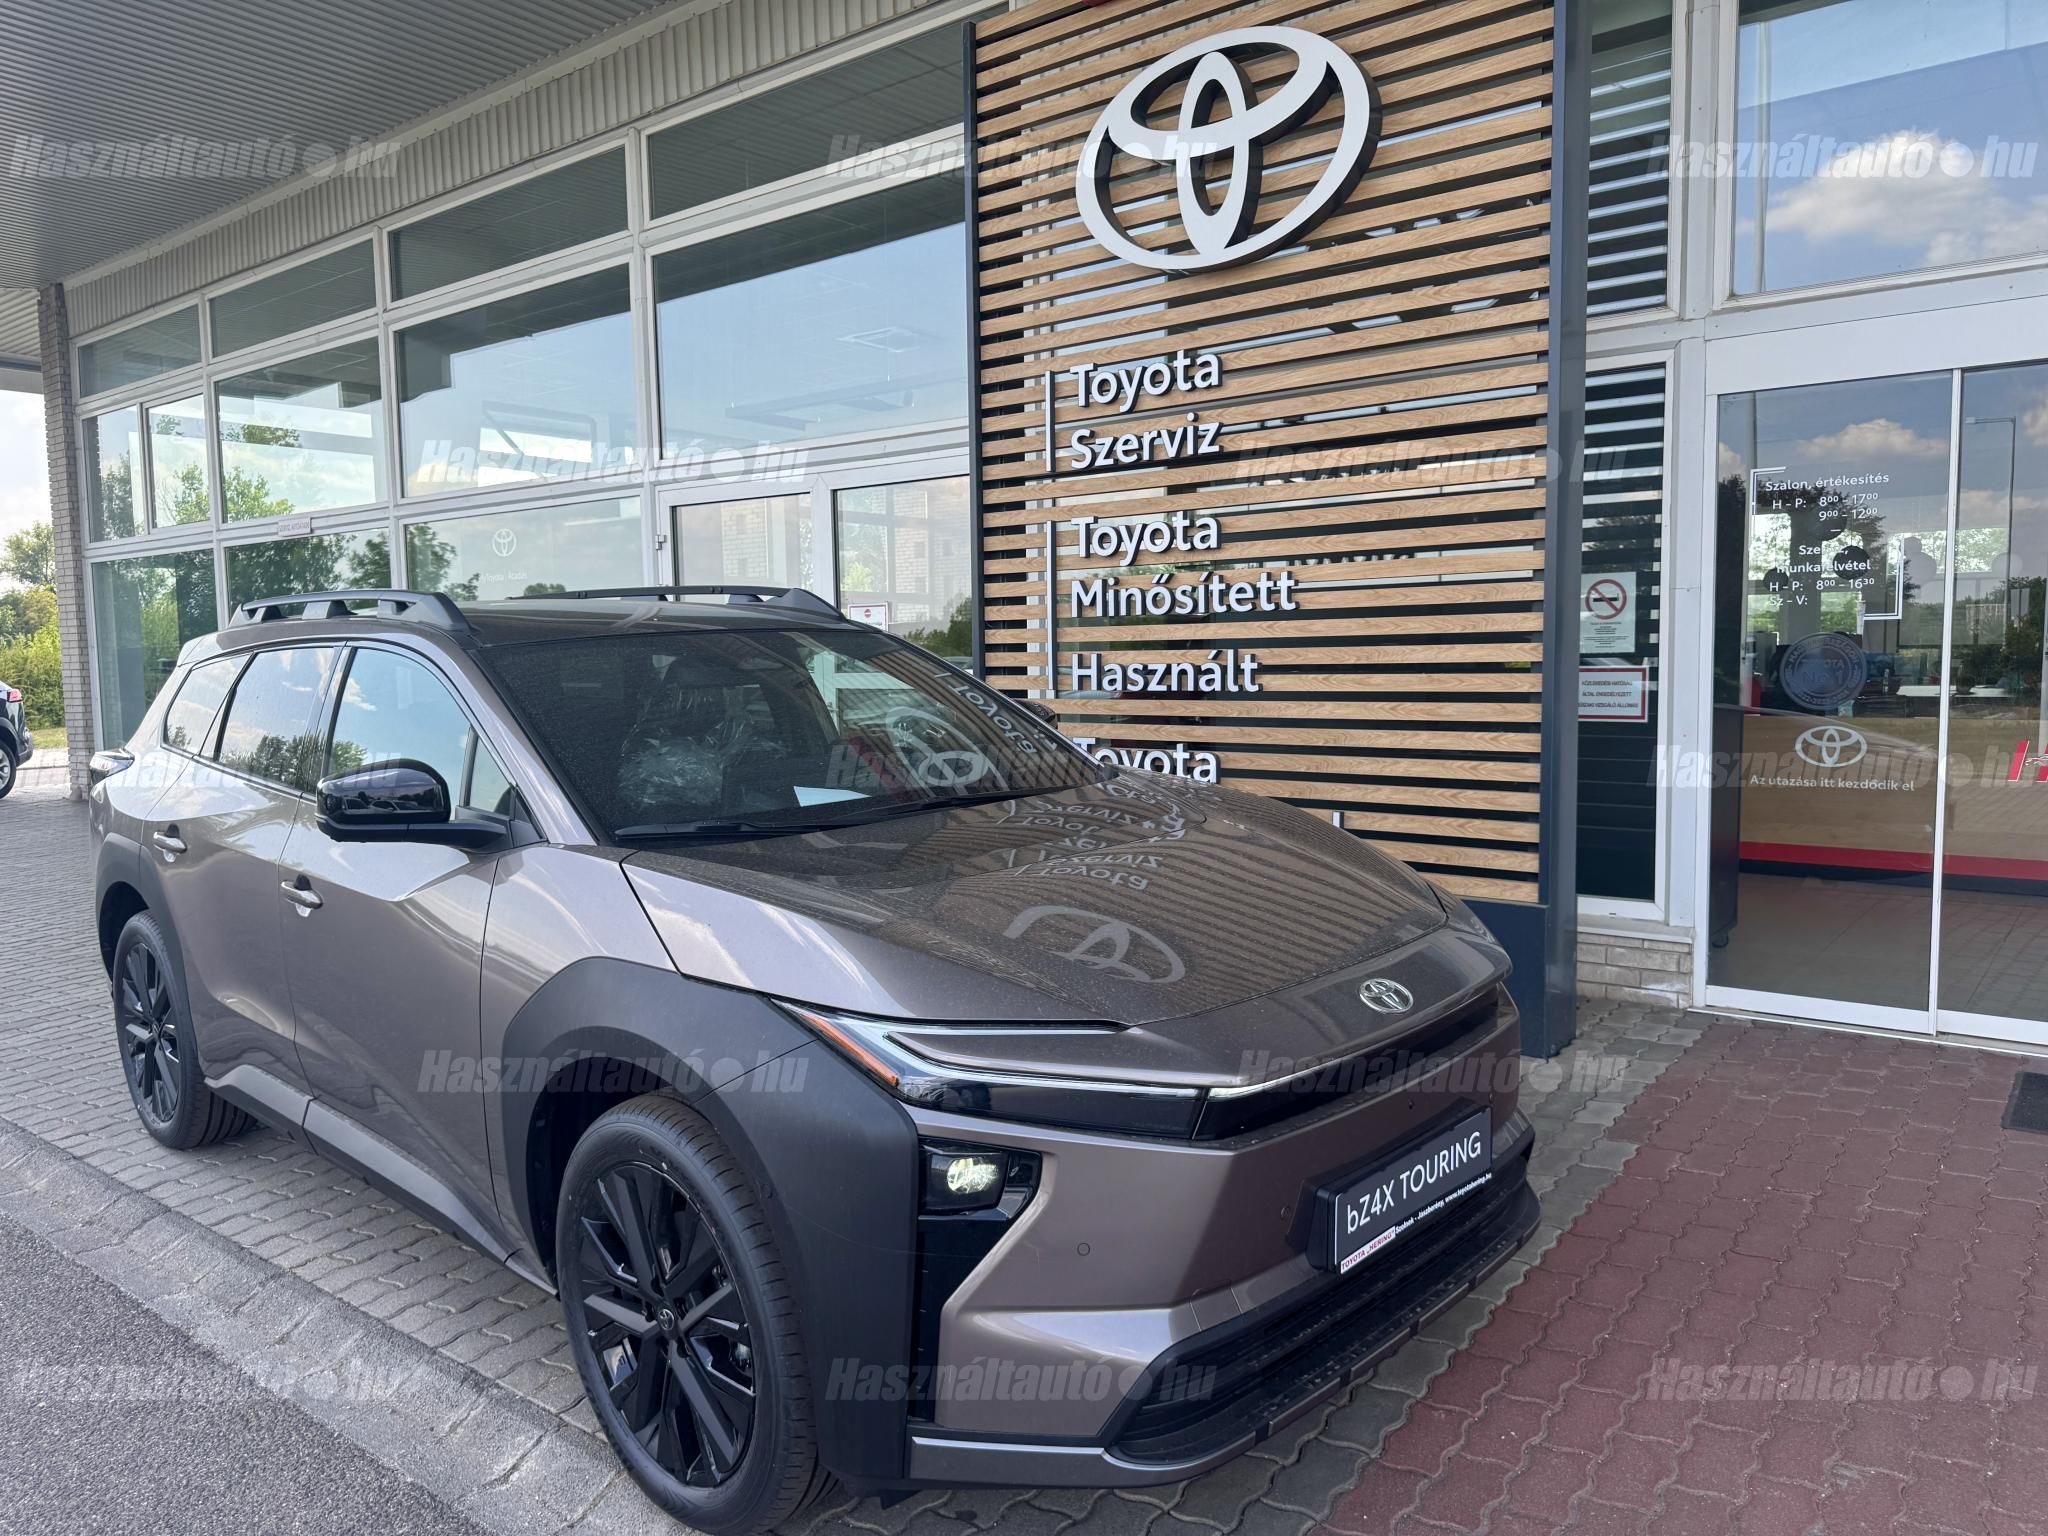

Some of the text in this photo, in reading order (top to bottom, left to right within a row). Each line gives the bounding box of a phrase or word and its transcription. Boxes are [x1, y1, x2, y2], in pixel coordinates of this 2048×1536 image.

[1070, 350, 1221, 412] Toyota
[1070, 413, 1221, 470] Szerviz
[1765, 473, 1889, 492] Szalon, értékesítés
[1772, 500, 1782, 509] H
[1795, 498, 1806, 508] P:
[1071, 511, 1220, 566] Toyota
[1071, 571, 1298, 618] Minősített
[1769, 582, 1779, 592] H
[1792, 581, 1803, 591] P:
[1796, 595, 1808, 605] V:
[1072, 649, 1261, 693] Használt
[1750, 775, 1914, 791] Az utazása itt kezdődik el
[1347, 1131, 1481, 1234] bZ4X TOURING
[1341, 1251, 1366, 1271] TOYOTA
